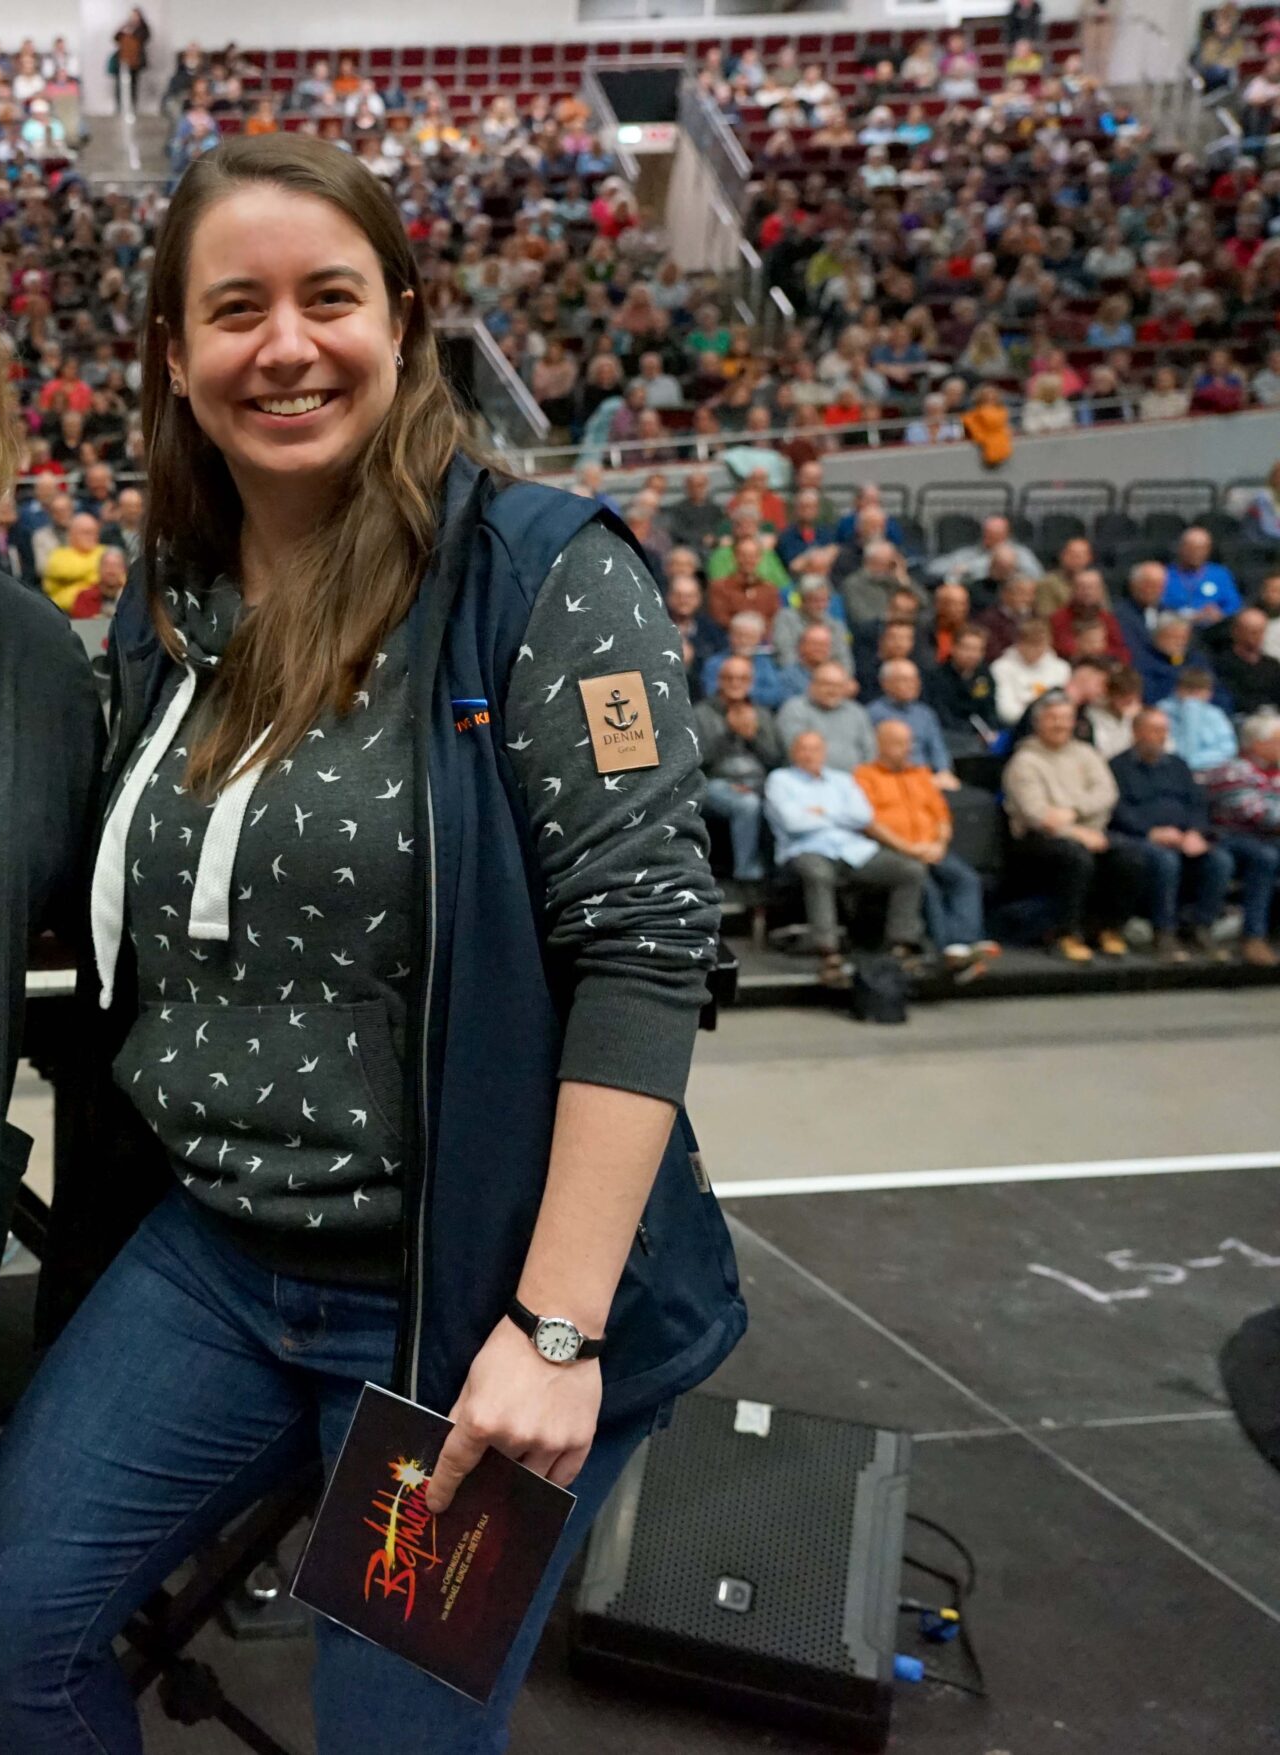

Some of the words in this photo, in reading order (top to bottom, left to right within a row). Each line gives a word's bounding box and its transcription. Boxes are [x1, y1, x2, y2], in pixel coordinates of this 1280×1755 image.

[603, 729, 644, 745] DENIM
[443, 1542, 466, 1585] CHORMUSICAL
[444, 1585, 460, 1610] MICHAEL
[455, 1561, 469, 1584] KUNZE
[467, 1529, 483, 1553] DIETER
[477, 1513, 490, 1530] FALK
